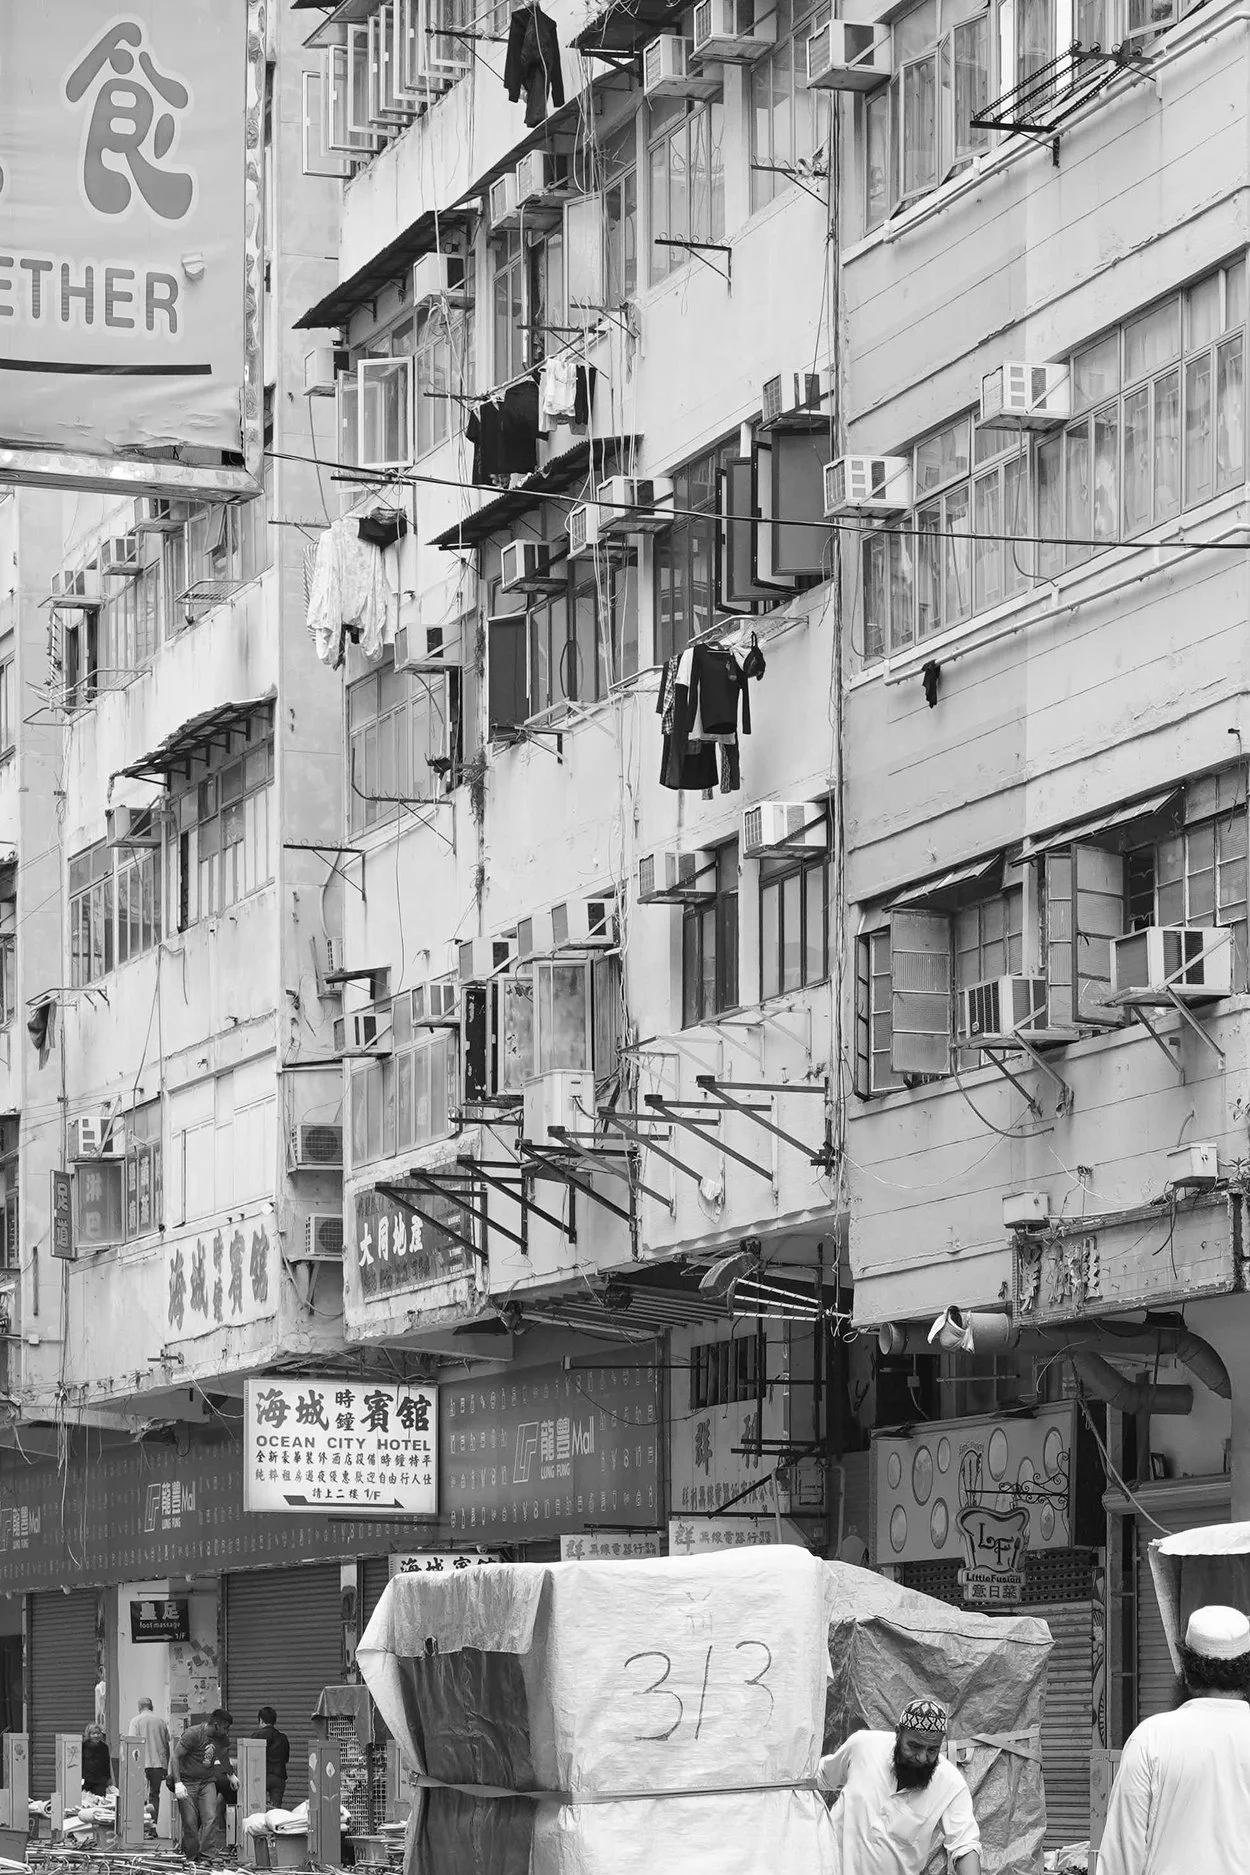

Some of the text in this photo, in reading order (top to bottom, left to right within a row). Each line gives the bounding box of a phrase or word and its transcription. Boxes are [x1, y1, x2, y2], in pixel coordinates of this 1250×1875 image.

[64, 21, 194, 221] 食
[255, 1434, 432, 1452] OCEAN CITY HOTEL
[363, 1488, 382, 1501] 1/F
[965, 1574, 1022, 1584] LittleFusion
[139, 1621, 181, 1630] foot massage
